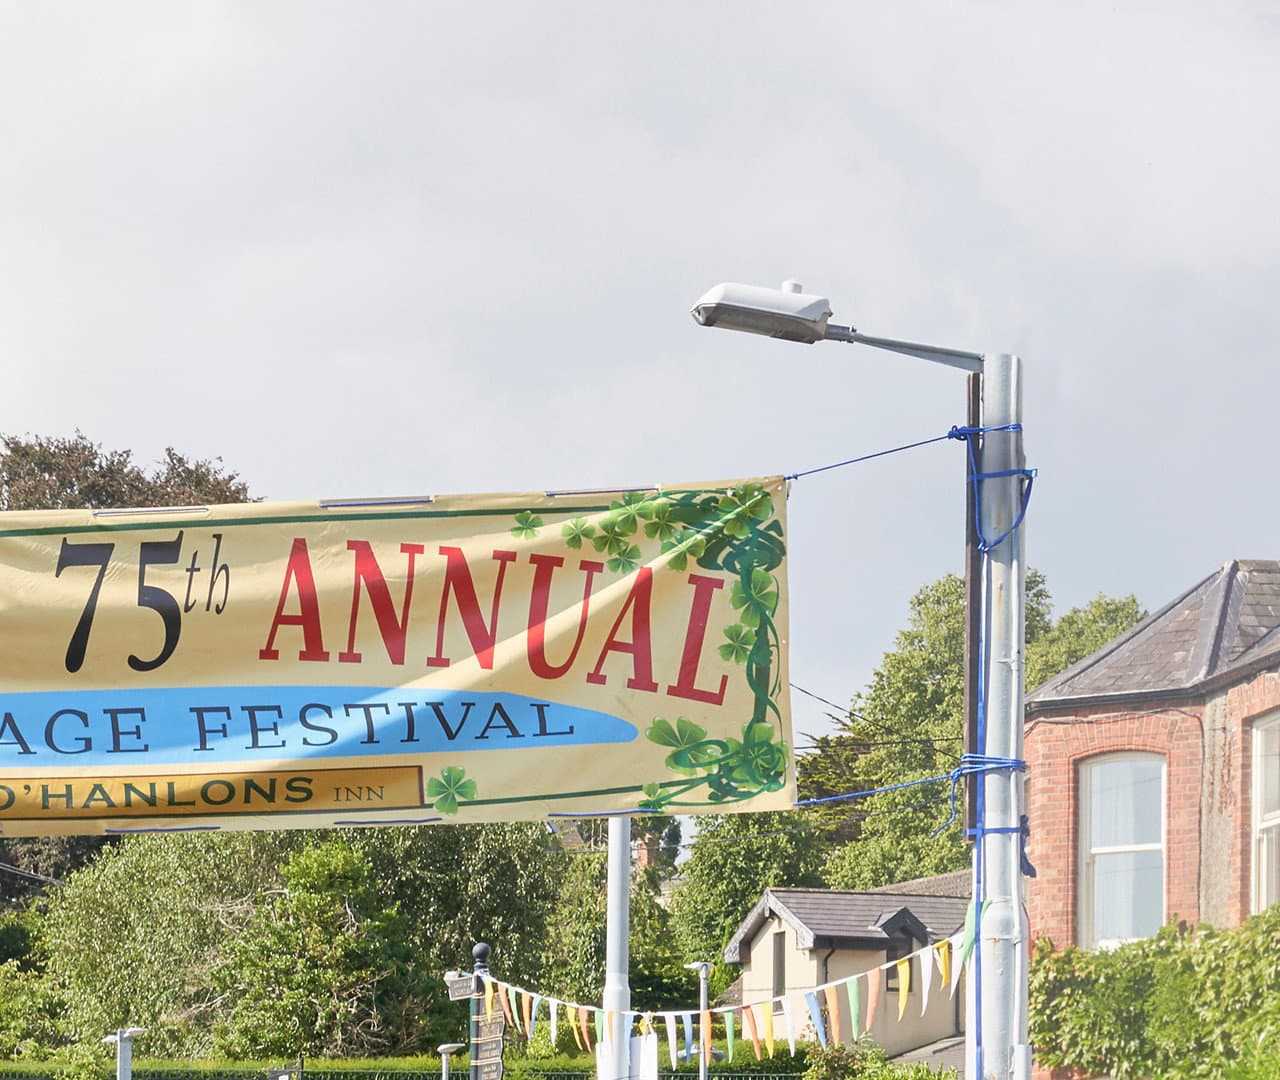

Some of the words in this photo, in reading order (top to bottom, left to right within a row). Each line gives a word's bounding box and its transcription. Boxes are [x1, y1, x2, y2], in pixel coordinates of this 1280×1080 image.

[54, 530, 231, 674] 75th
[258, 537, 729, 706] ANNUAL
[190, 702, 575, 752] FESTIVAL
[333, 785, 385, 803] INN
